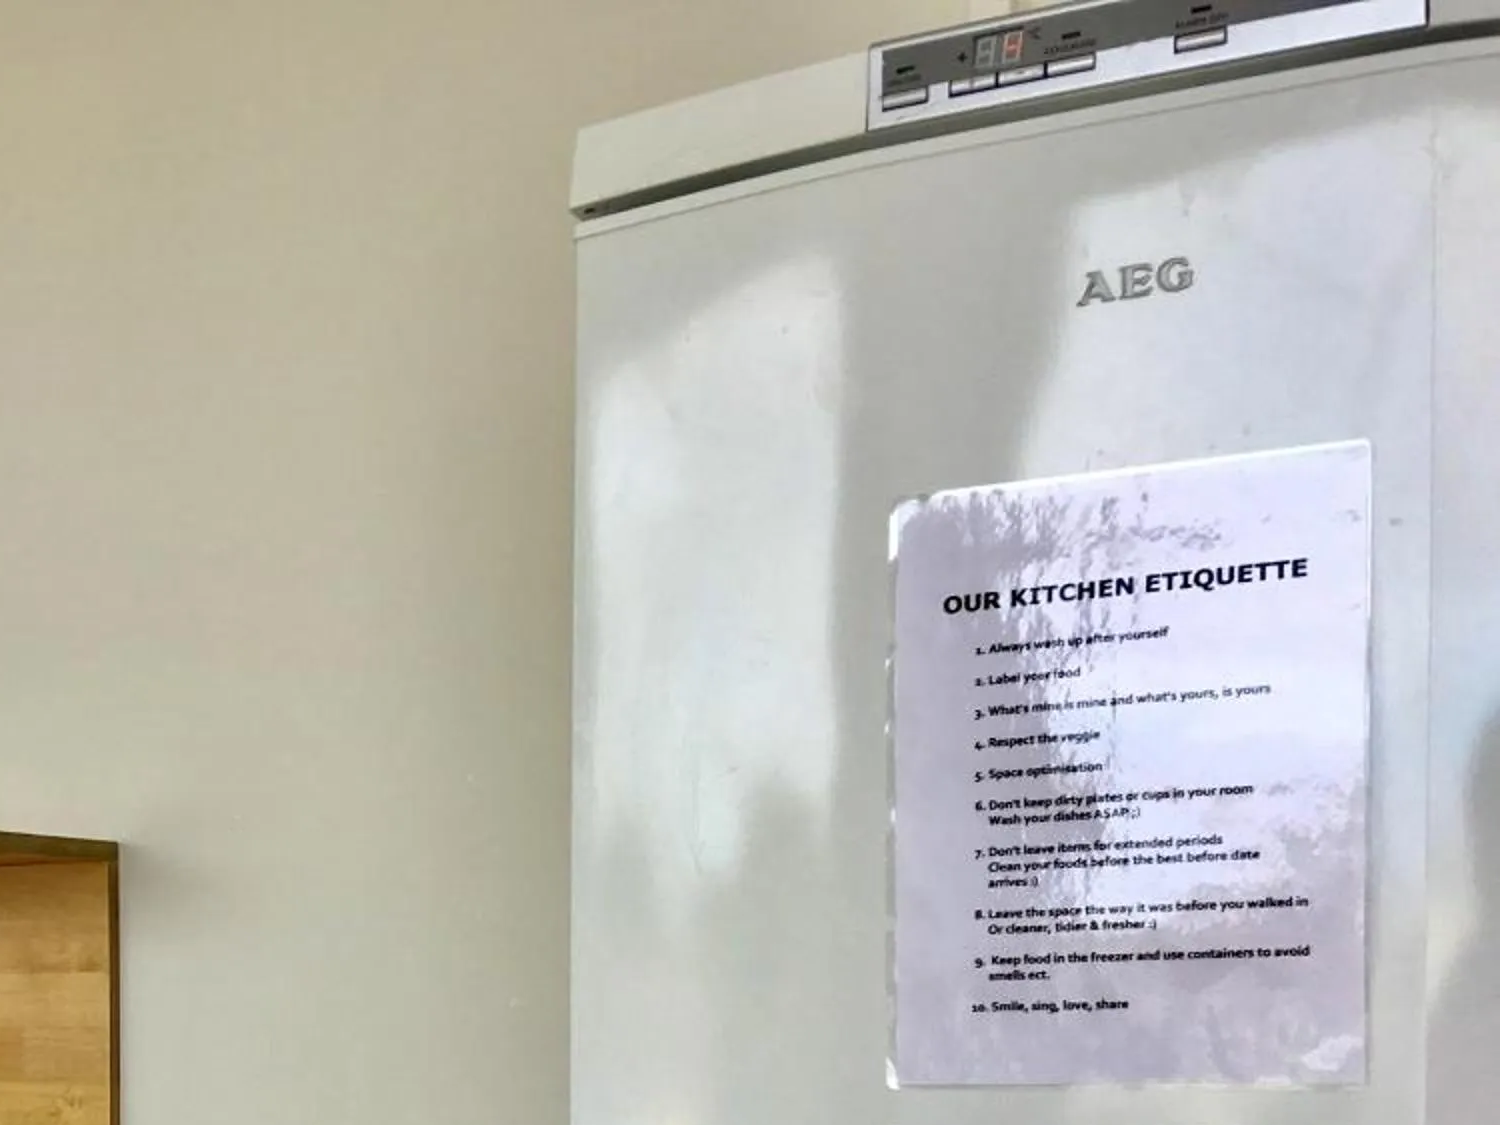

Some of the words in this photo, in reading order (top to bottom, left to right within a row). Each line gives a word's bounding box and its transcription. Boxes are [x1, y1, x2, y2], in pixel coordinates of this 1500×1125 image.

[1076, 256, 1194, 307] AEG
[943, 592, 1001, 614] OUR
[1011, 577, 1135, 608] KITCHEN
[1145, 558, 1308, 592] ETIQUETTE
[988, 641, 1031, 654] Always
[1033, 638, 1064, 649] wash
[1067, 638, 1082, 649] up
[1086, 633, 1115, 644] after
[1118, 625, 1170, 644] yourself
[988, 672, 1021, 686] Label
[1023, 672, 1050, 685] your
[1052, 667, 1081, 679] food
[988, 703, 1029, 716] What's
[1031, 701, 1061, 712] mine
[1064, 700, 1074, 709] is
[1076, 698, 1106, 708] mine
[1110, 694, 1133, 705] and
[1136, 691, 1177, 703] what's
[1180, 689, 1219, 702] yours,
[1222, 685, 1233, 697] is
[1235, 684, 1271, 698] yours
[988, 735, 1035, 748] Respect
[1037, 732, 1058, 743] the
[1061, 729, 1100, 744] veggie
[988, 768, 1023, 781] Space
[1026, 762, 1103, 778] optimisation
[975, 800, 986, 811] 6.
[988, 799, 1021, 810] Don't
[1023, 797, 1052, 809] keep
[1054, 795, 1082, 807] dirty
[1085, 793, 1124, 806] plates
[1126, 792, 1138, 801] or
[1142, 790, 1170, 801] cups
[1172, 788, 1184, 798] in
[1187, 788, 1216, 800] your
[1219, 785, 1254, 796] room
[988, 814, 1021, 825] Wash
[1024, 814, 1051, 826] your
[1053, 810, 1092, 822] dishes
[974, 850, 986, 860] 7.
[988, 845, 1020, 857] Don't
[1023, 844, 1054, 855] leave
[1057, 841, 1091, 853] items
[1093, 840, 1111, 850] for
[1114, 837, 1173, 850] extended
[1176, 834, 1223, 849] periods
[988, 861, 1021, 872] Clean
[1024, 862, 1051, 873] your
[1053, 858, 1088, 870] foods
[1090, 856, 1129, 867] before
[1133, 854, 1153, 865] the
[1156, 853, 1183, 864] best
[1186, 850, 1228, 862] before
[1230, 849, 1261, 861] date
[988, 878, 1027, 888] arrives
[988, 909, 1023, 919] Leave
[1025, 907, 1046, 917] the
[1049, 907, 1082, 919] space
[1085, 905, 1105, 916] the
[1108, 906, 1133, 916] way
[1136, 901, 1145, 912] it
[1150, 903, 1173, 912] was
[1175, 899, 1217, 911] before
[1220, 900, 1244, 912] you
[1247, 896, 1293, 909] walked
[1295, 896, 1309, 907] in
[987, 924, 1002, 935] Or
[1005, 923, 1051, 935] cleaner,
[1055, 921, 1087, 933] tidier
[1089, 920, 1099, 930] &
[1102, 919, 1145, 930] fresher
[991, 955, 1021, 967] Keep
[1023, 953, 1050, 965] food
[1053, 952, 1065, 963] in
[1067, 952, 1088, 963] the
[1091, 952, 1133, 963] freezer
[1136, 949, 1160, 960] and
[1163, 951, 1184, 960] use
[1187, 948, 1254, 959] containers
[1257, 947, 1271, 957] to
[1274, 944, 1311, 957] avoid
[989, 970, 1026, 981] smells
[1028, 971, 1050, 981] ect.
[991, 1001, 1028, 1013] Smile,
[1031, 1001, 1060, 1014] sing,
[1063, 1000, 1093, 1012] love,
[1095, 998, 1129, 1010] share
